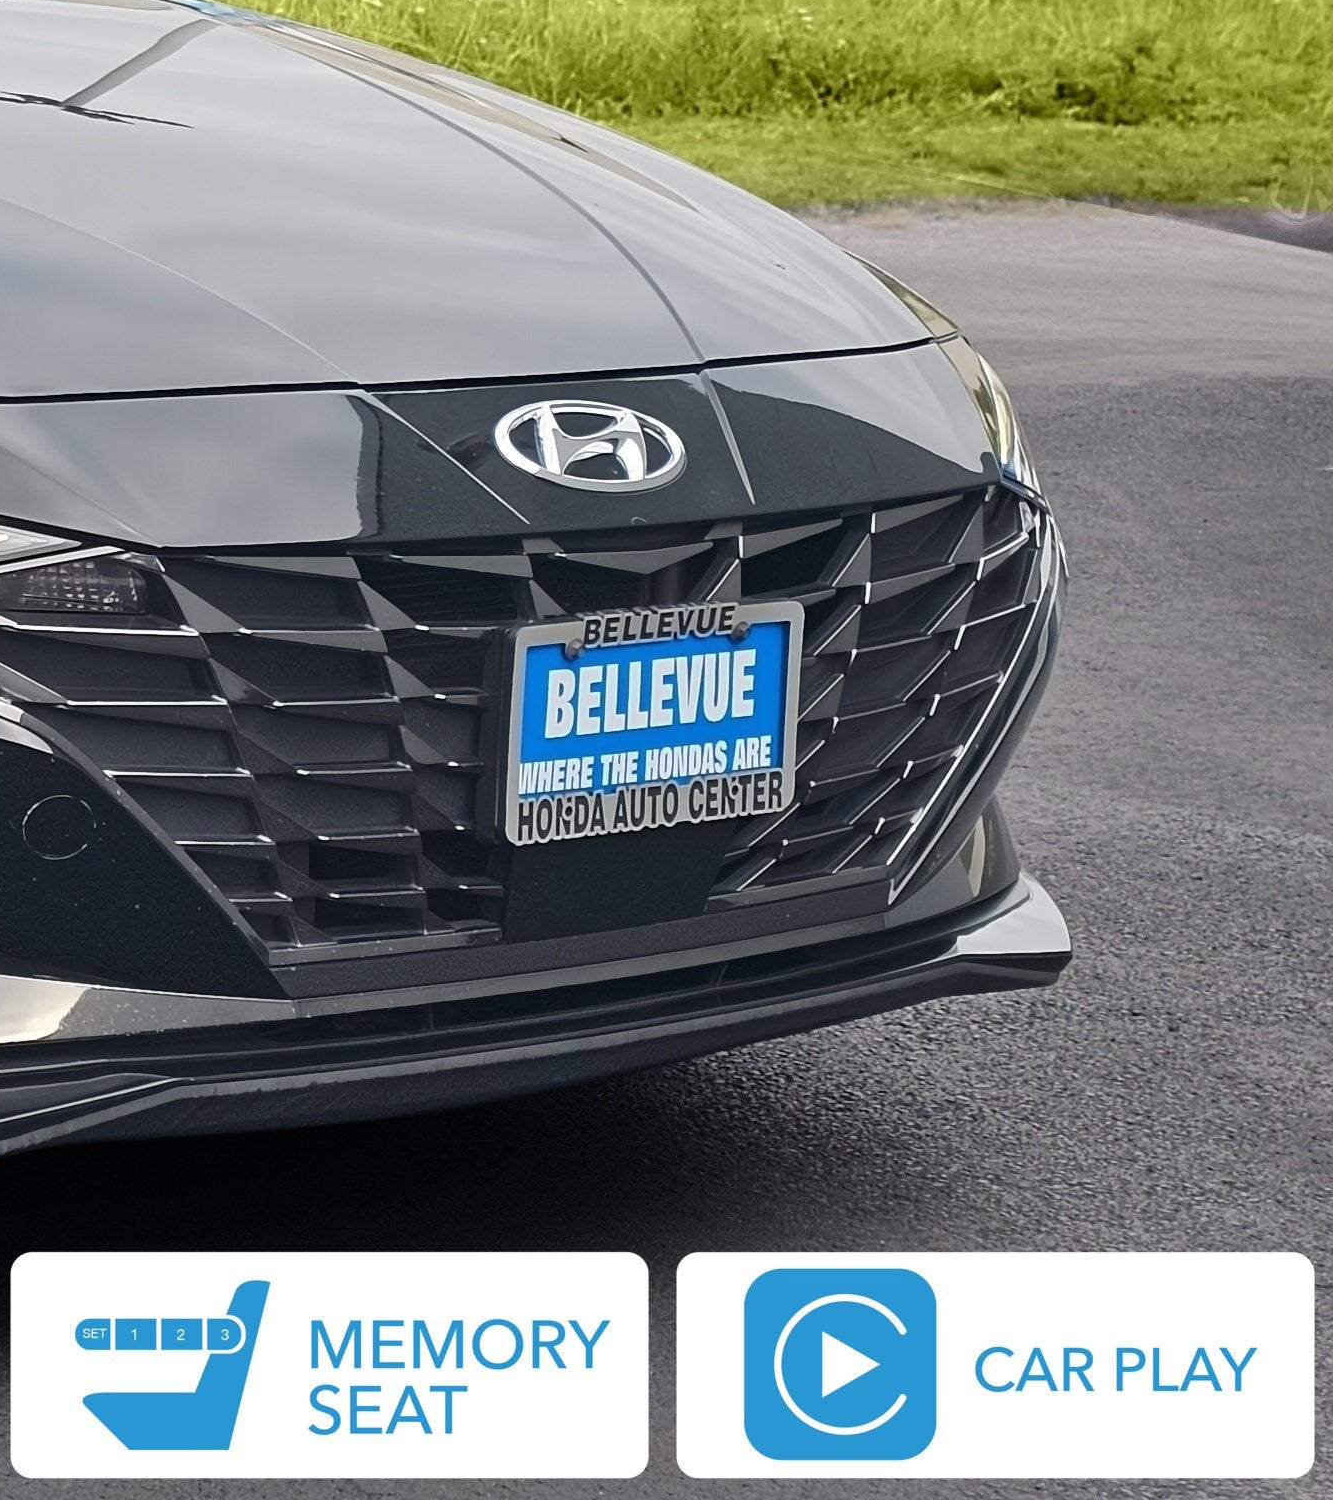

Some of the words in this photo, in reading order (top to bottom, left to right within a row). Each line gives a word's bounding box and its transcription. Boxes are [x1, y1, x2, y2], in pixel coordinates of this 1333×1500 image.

[583, 605, 736, 645] BELLEVUE
[544, 649, 757, 739] BELLEVUE
[518, 756, 595, 795] WHERE
[600, 751, 639, 786] THE
[644, 740, 728, 781] HONDAS
[732, 735, 772, 771] ARE
[517, 790, 606, 842] HONDA
[612, 783, 679, 832] AUTO
[688, 770, 783, 821] CENTER
